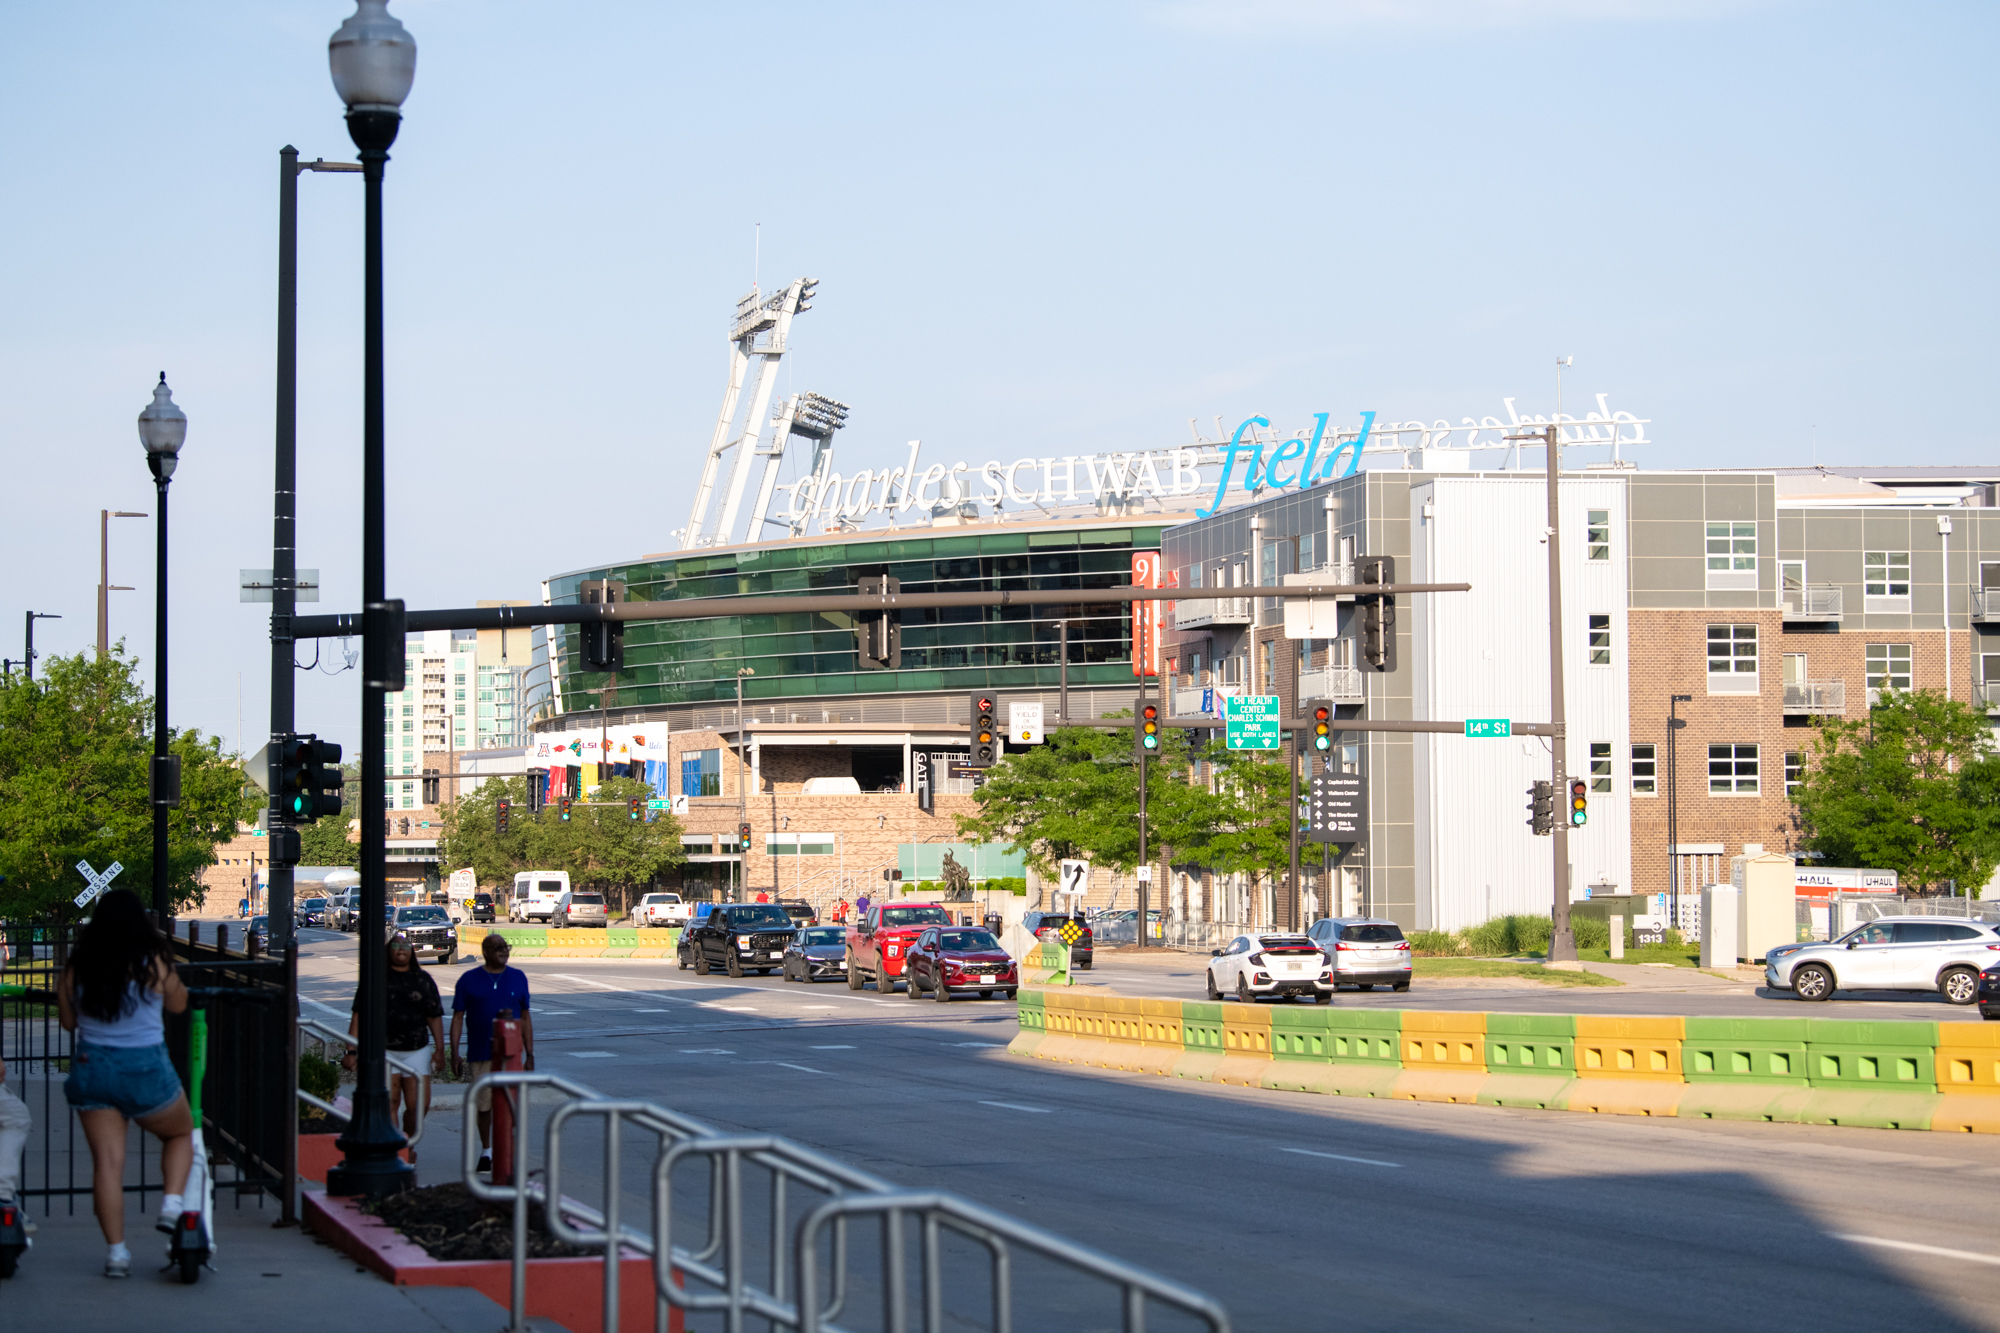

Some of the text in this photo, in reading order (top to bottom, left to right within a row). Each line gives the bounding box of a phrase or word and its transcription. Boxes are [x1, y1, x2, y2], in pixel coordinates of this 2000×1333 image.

[788, 411, 1377, 521] charles SCHWAB field
[1233, 696, 1272, 705] CHI HEALTH
[1239, 705, 1266, 714] CENTER
[1228, 714, 1279, 722] CHARLES SCHWAB
[1244, 723, 1262, 732] PARK
[1469, 722, 1506, 734] 14th St
[917, 752, 927, 788] GATE
[76, 863, 122, 906] CROSSING
[1638, 933, 1663, 944] 1313
